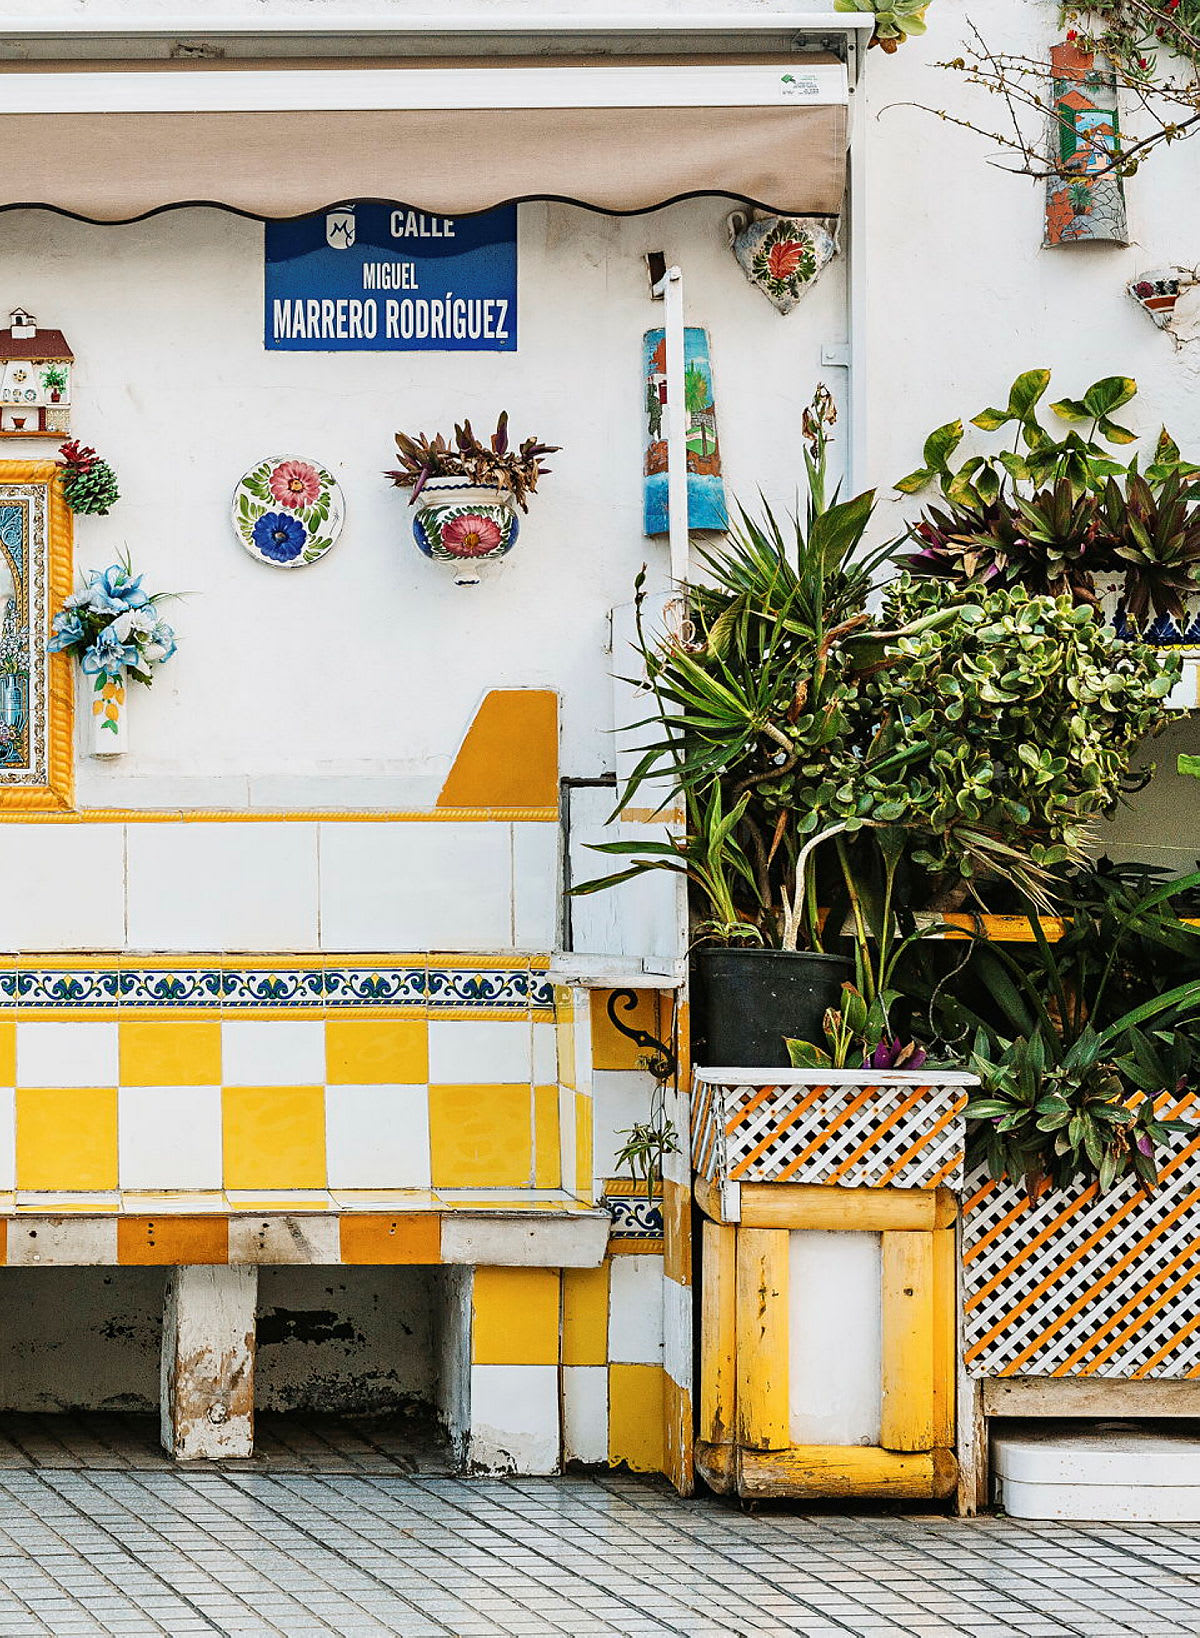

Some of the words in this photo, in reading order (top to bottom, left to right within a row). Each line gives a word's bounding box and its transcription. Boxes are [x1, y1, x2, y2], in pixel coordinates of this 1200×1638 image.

[390, 210, 455, 238] CALLE
[363, 262, 419, 290] MIGUEL
[273, 298, 377, 339] MARRERO
[386, 292, 508, 339] RODRÍGUEZ
